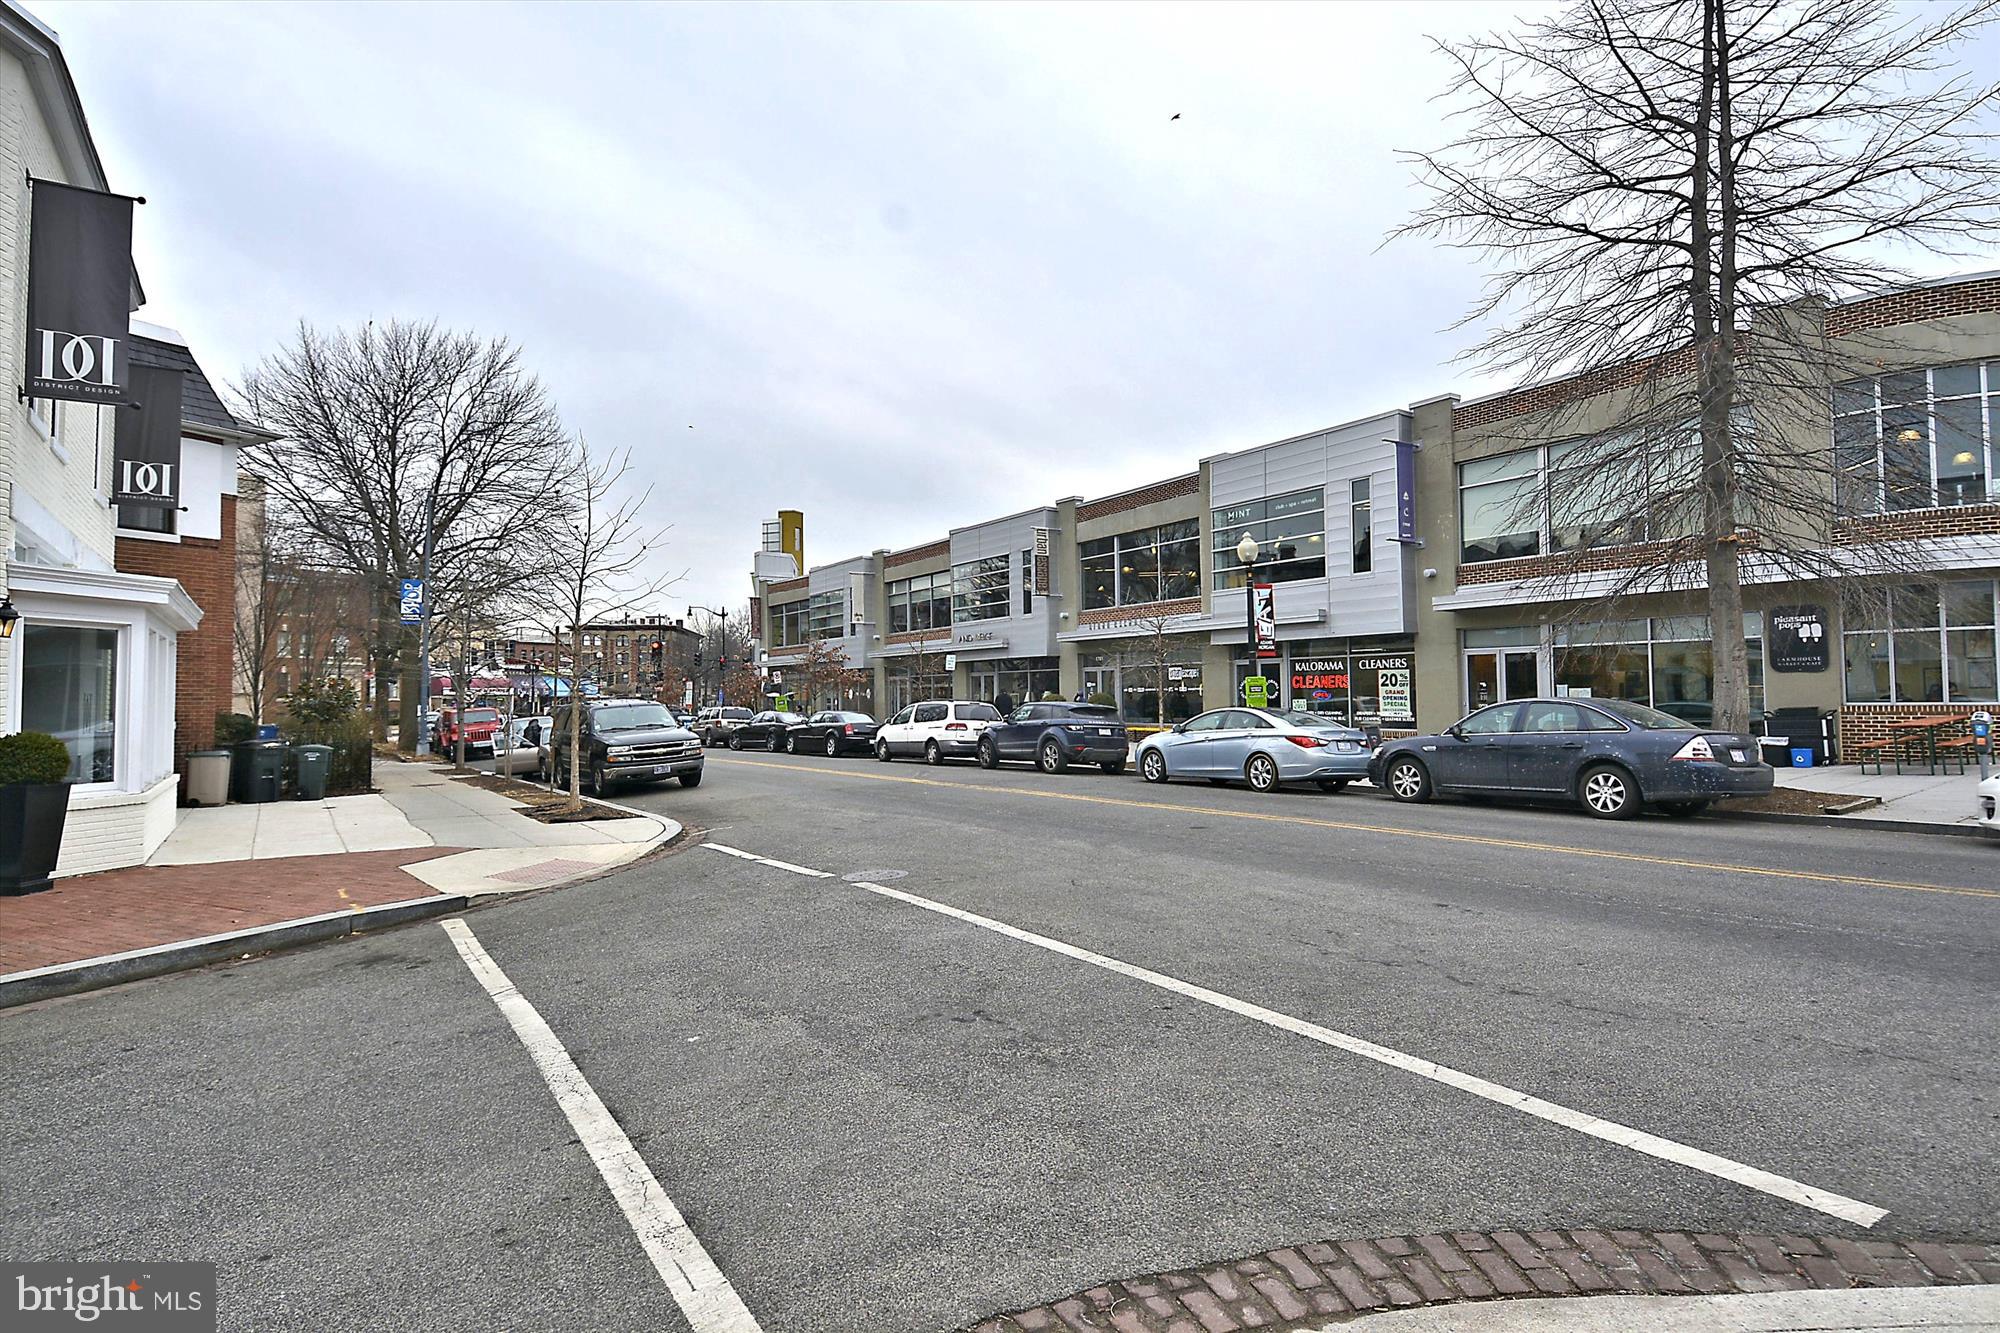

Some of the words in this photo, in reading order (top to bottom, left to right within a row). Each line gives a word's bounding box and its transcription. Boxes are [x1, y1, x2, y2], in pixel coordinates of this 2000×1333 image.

[33, 381, 80, 391] DISTRICT
[85, 386, 120, 395] DESIGN
[1227, 507, 1251, 521] MINT
[1036, 528, 1048, 555] urban
[1036, 556, 1049, 588] escape
[1255, 590, 1275, 639] EAT
[1774, 615, 1817, 625] pleasant
[1778, 622, 1802, 630] pops
[1295, 661, 1344, 671] KALORAMA
[1359, 658, 1407, 669] CLEANERS
[1292, 674, 1349, 689] CLEANERS
[1380, 673, 1399, 687] 20
